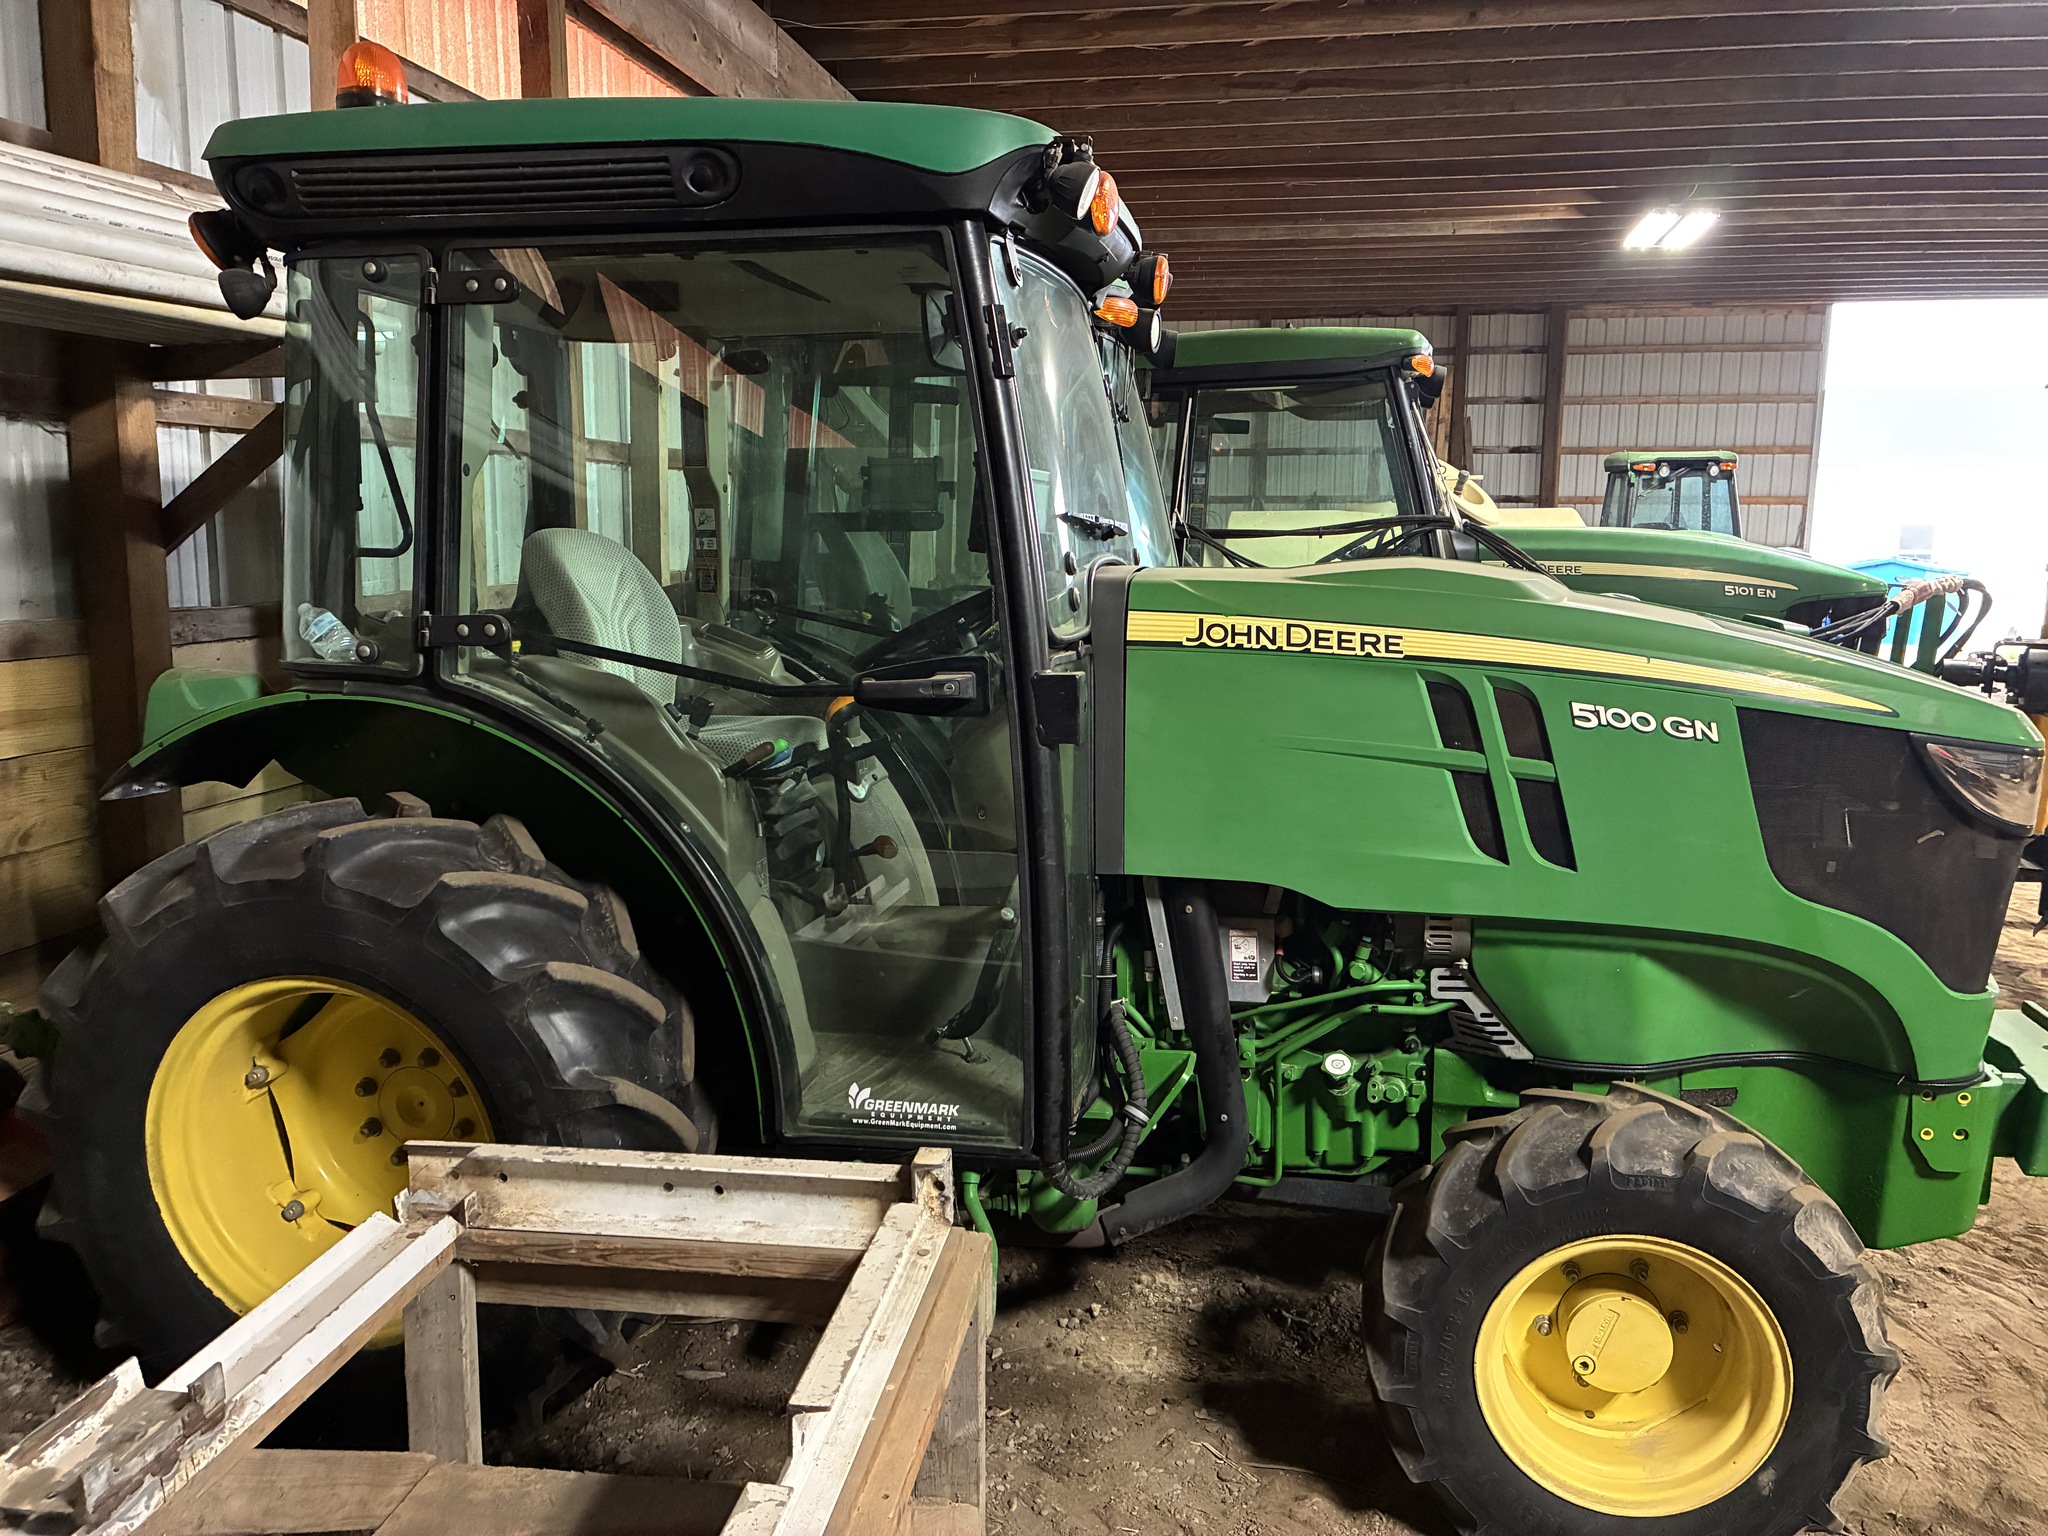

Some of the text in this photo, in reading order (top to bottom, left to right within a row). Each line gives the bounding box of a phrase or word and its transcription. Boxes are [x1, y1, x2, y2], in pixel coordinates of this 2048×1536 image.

[1724, 585, 1776, 599] 5101 EN
[1185, 617, 1404, 655] JOHN DEERE
[1569, 701, 1720, 744] 5100 GN
[864, 1099, 960, 1117] GREENMARK
[852, 1117, 957, 1131] www.GreenMarkEquipment.com
[870, 1111, 952, 1123] EQUIPMENT
